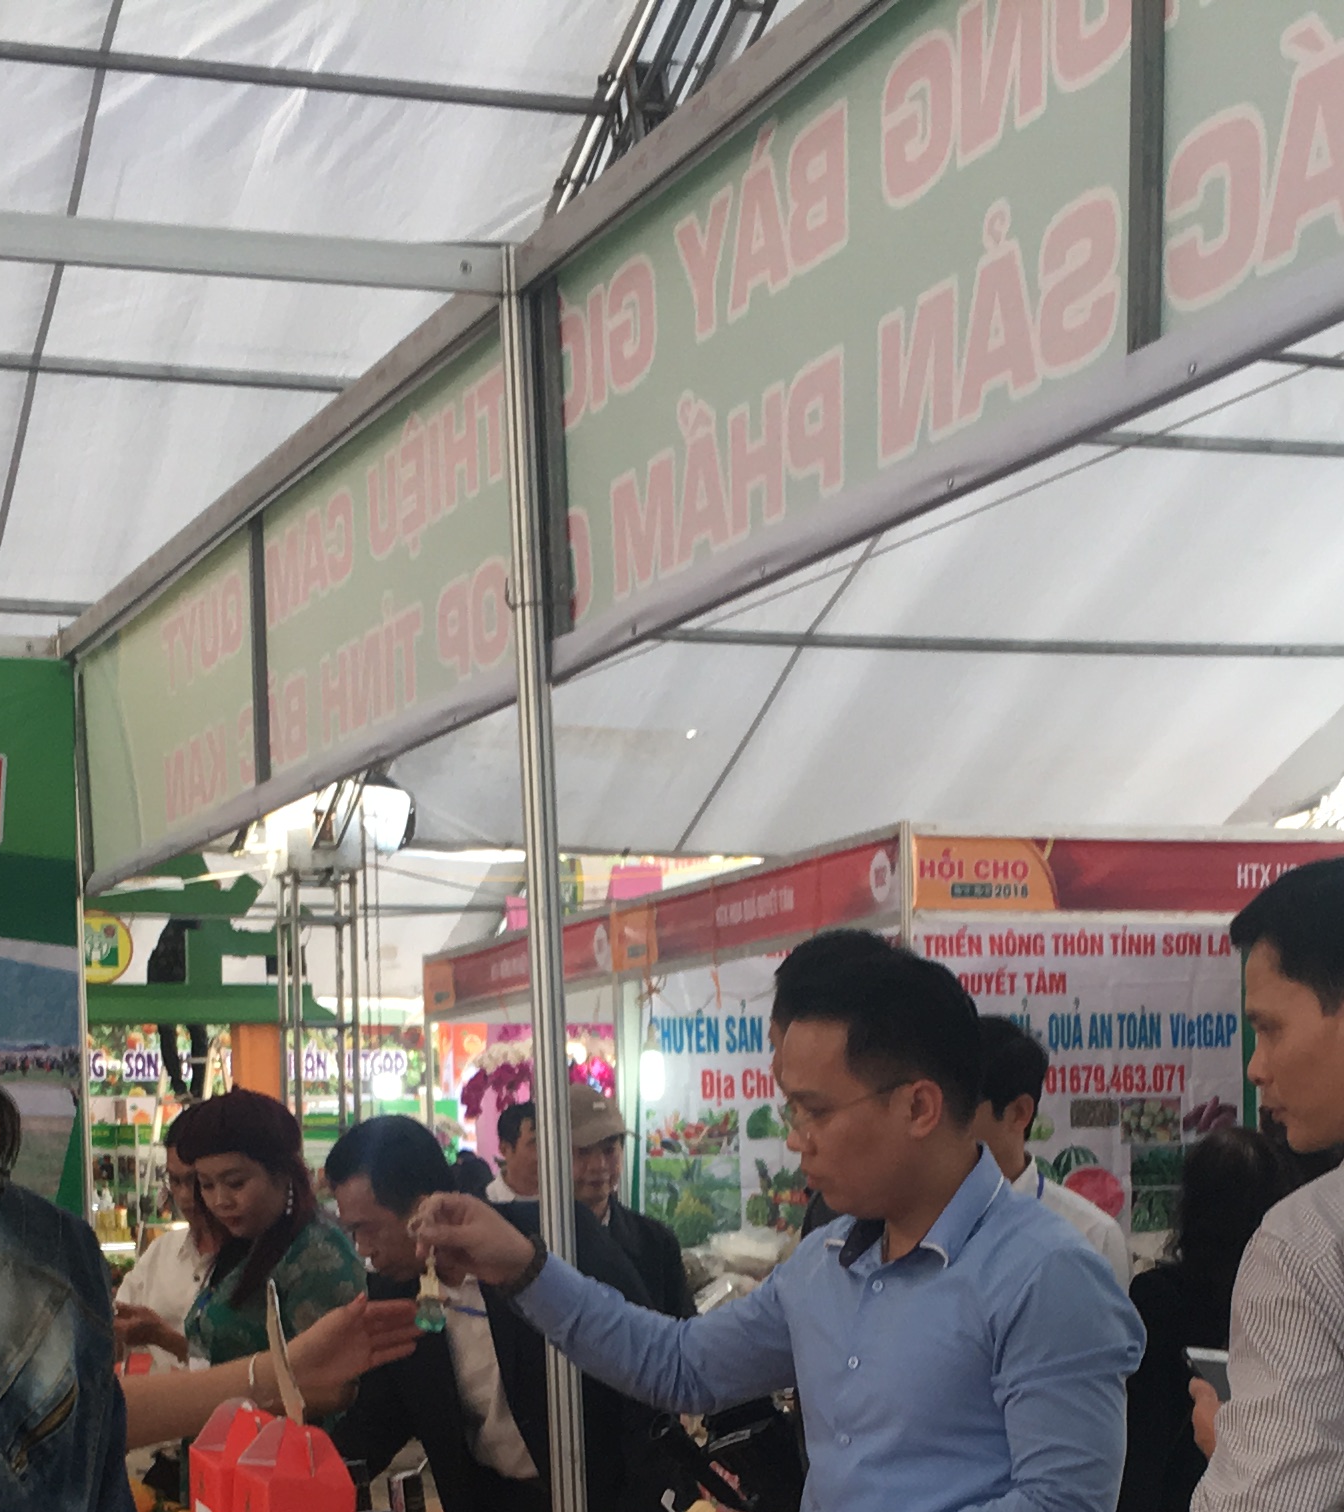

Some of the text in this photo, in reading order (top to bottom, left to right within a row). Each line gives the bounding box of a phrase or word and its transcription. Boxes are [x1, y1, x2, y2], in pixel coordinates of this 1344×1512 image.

[923, 924, 984, 959] TRIỂN
[989, 927, 1046, 958] NÔNG
[1052, 927, 1105, 957] THÔN
[1024, 967, 1068, 996] TÂM
[1087, 1012, 1113, 1050] AN
